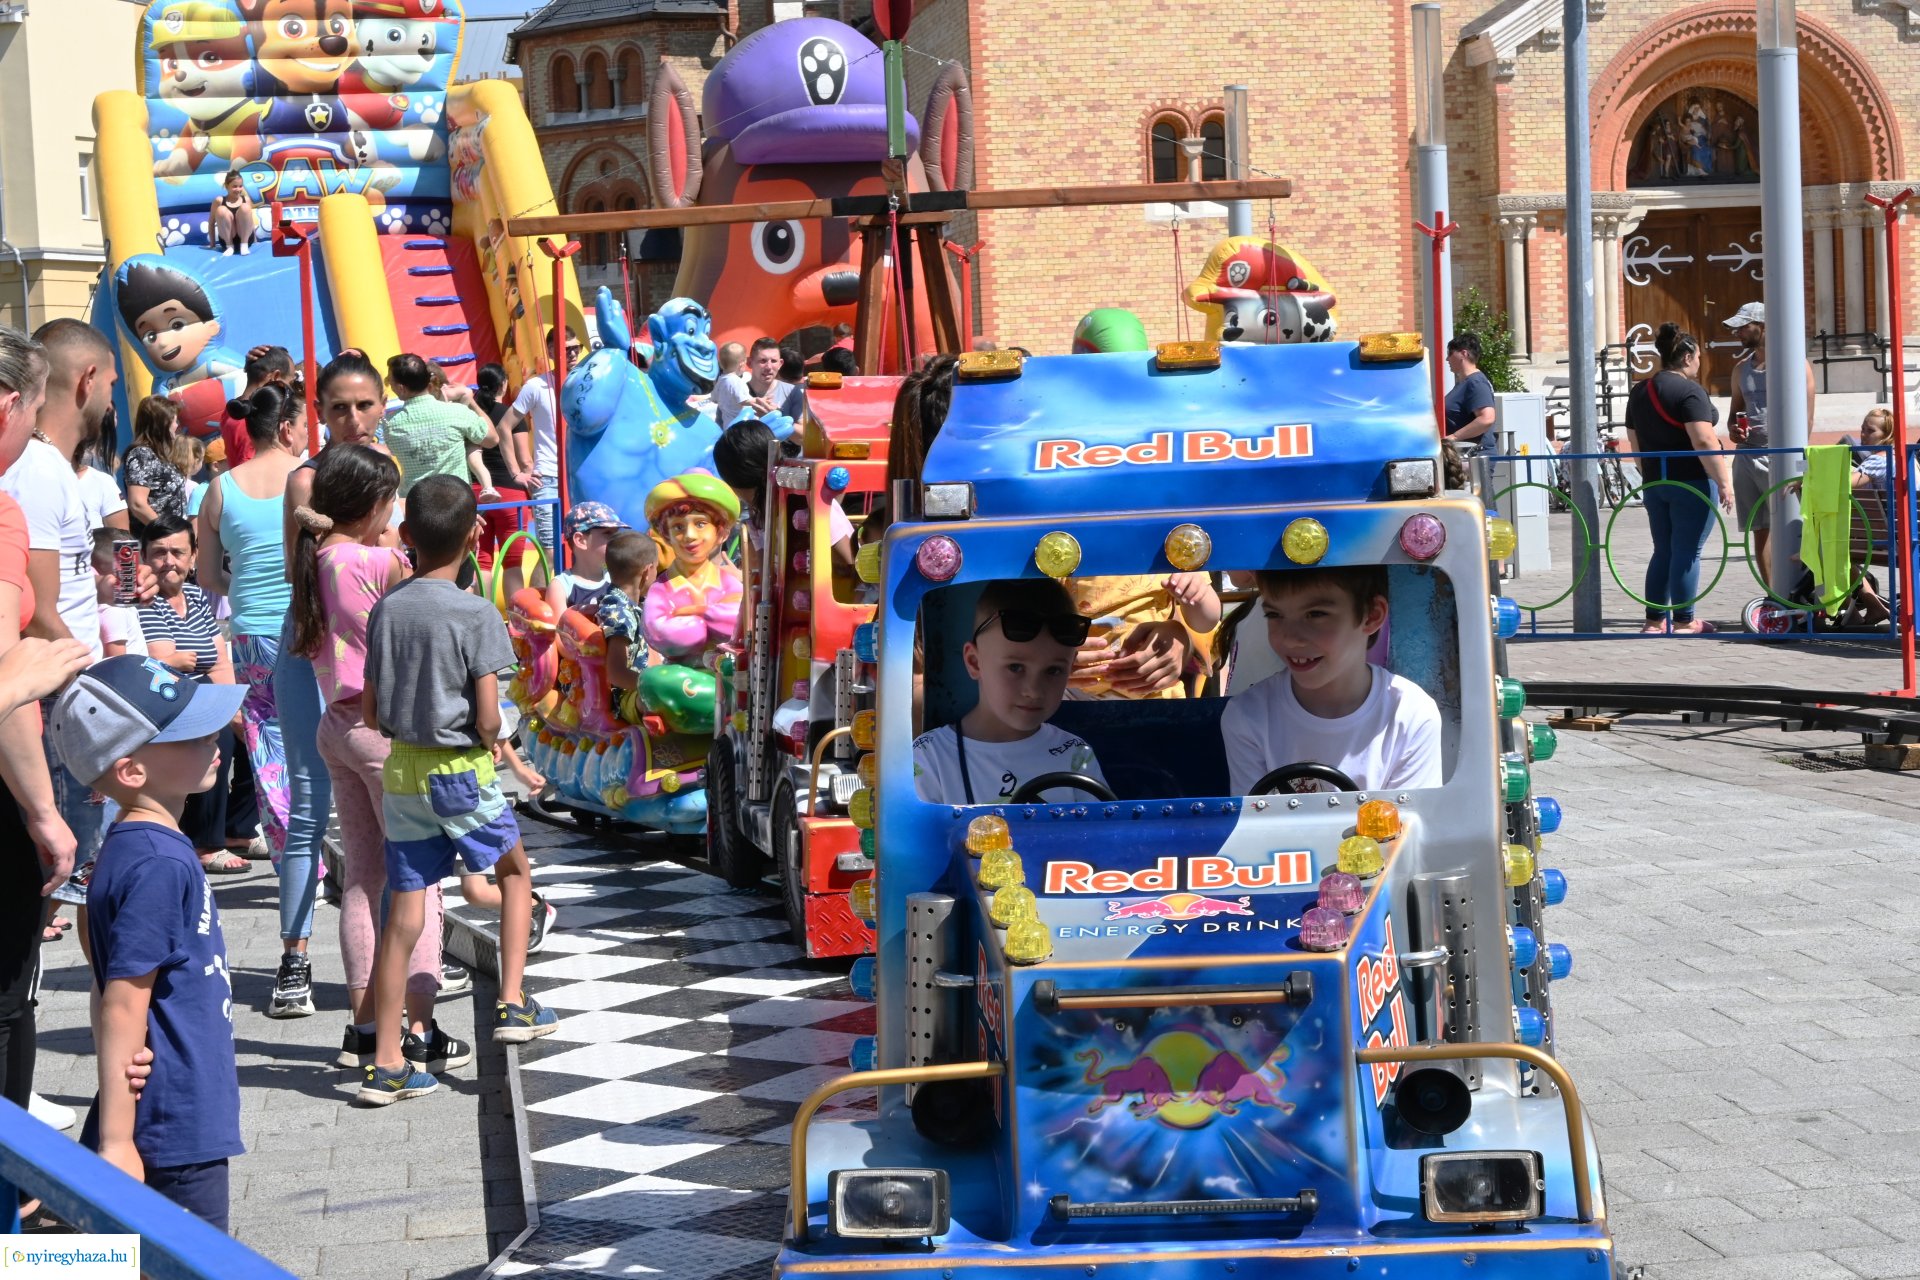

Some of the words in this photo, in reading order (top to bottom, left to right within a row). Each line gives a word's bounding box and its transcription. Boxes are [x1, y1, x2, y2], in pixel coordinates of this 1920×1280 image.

[238, 157, 375, 207] PAW
[1035, 432, 1173, 470] Red
[1183, 424, 1313, 462] Bull
[1045, 857, 1178, 893] Red
[1187, 851, 1312, 889] Bull
[1059, 923, 1190, 938] ENERGY
[1203, 917, 1302, 933] DRINK
[1357, 914, 1399, 1033] Red
